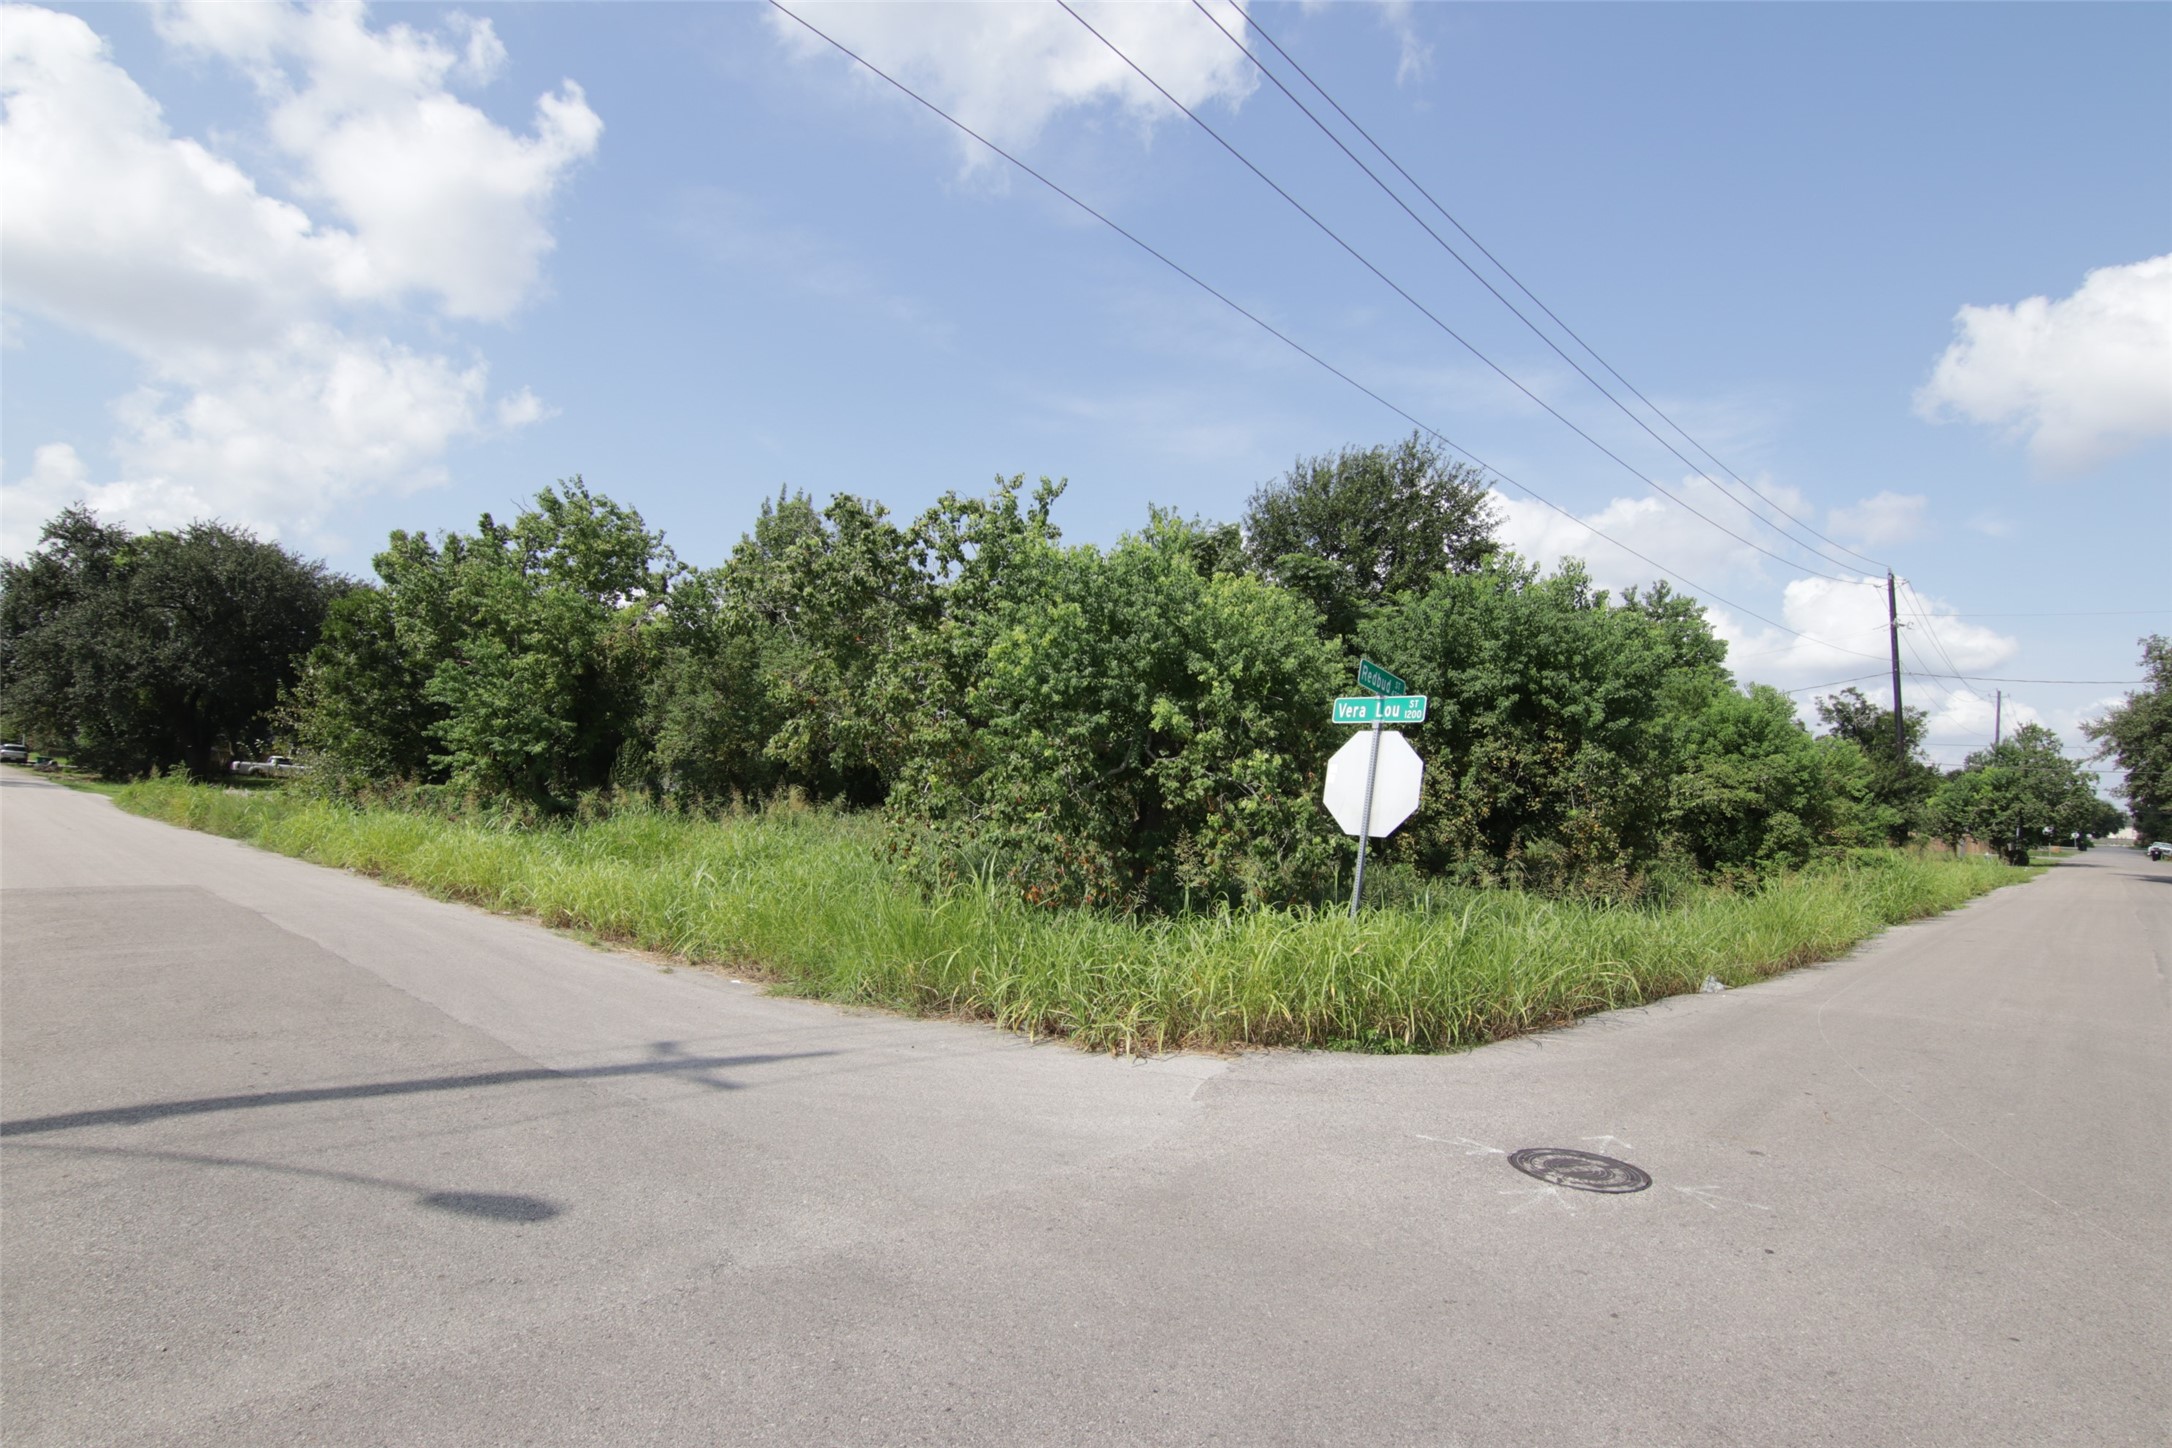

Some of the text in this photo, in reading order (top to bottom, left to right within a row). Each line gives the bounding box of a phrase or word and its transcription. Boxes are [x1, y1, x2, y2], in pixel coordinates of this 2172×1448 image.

[1361, 665, 1392, 692] Redbud
[1338, 699, 1419, 718] Vera Lou ST
[1404, 710, 1422, 719] 1200
